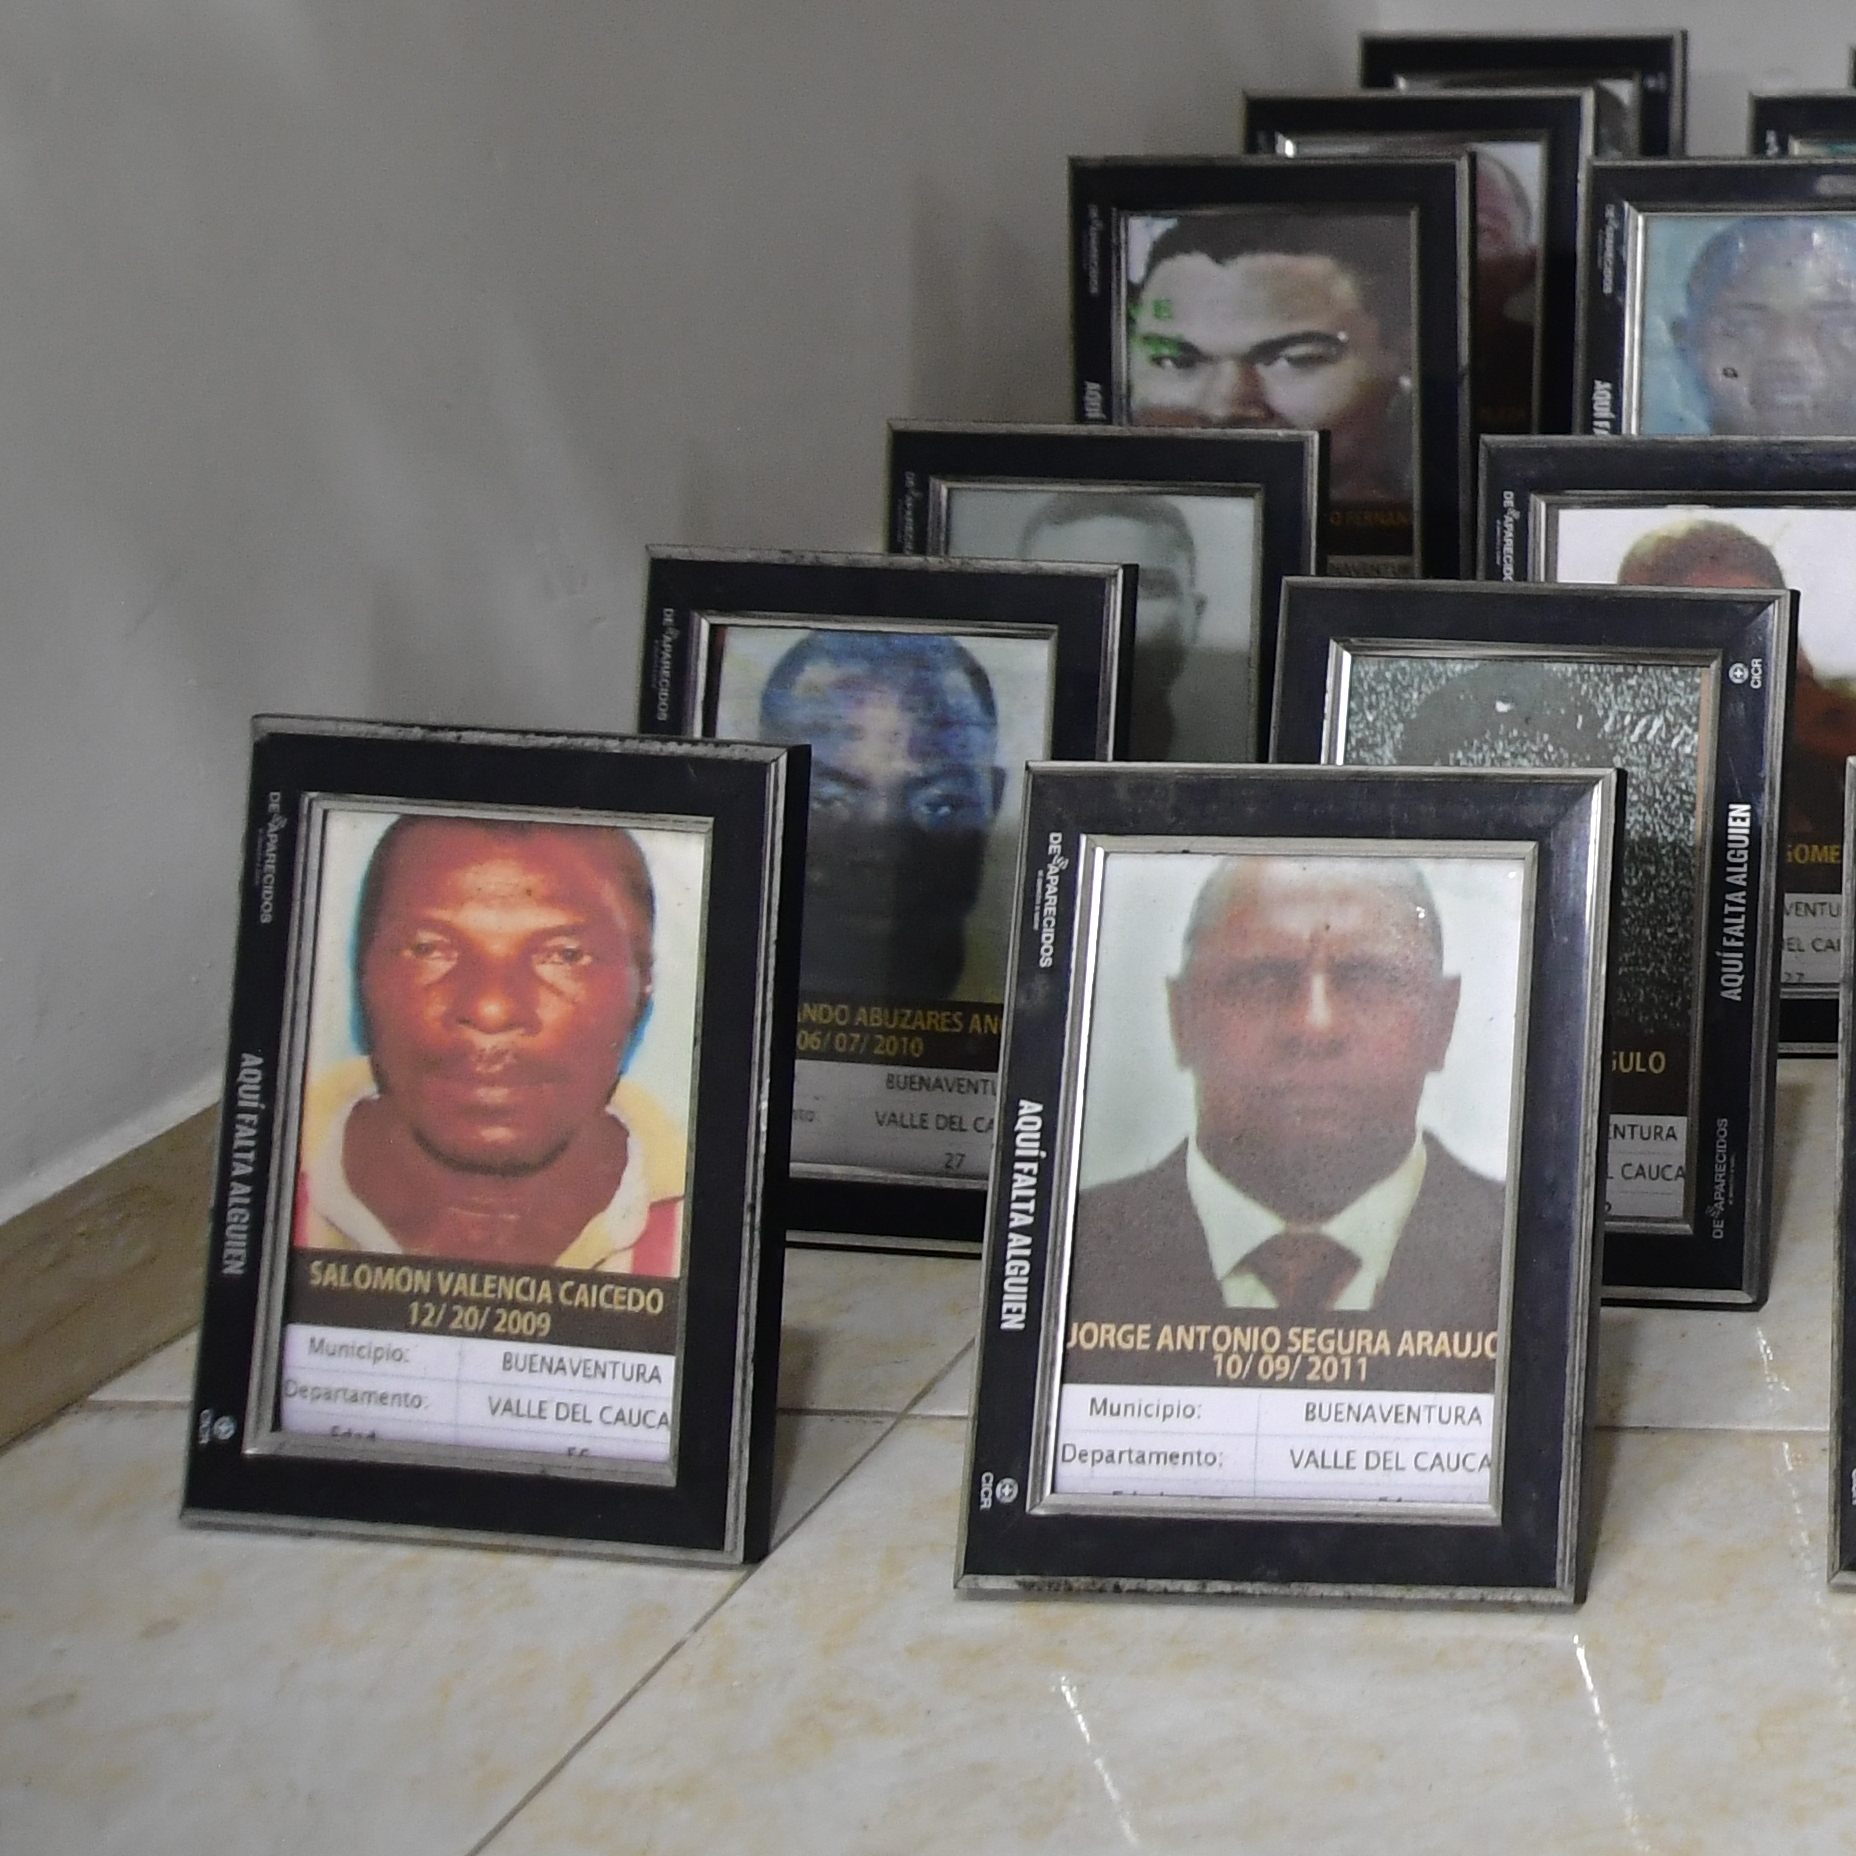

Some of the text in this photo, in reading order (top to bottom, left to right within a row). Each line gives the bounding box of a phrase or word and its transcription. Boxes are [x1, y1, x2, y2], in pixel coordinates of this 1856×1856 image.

[1727, 803, 1752, 886] ALGUIEN
[1722, 892, 1747, 945] FALTA
[855, 1007, 963, 1032] ABUZARES
[875, 1111, 929, 1129] VALLE
[935, 1114, 968, 1132] DEL
[222, 1052, 266, 1276] AQUÍ FALTA ALGUIEN
[1000, 1099, 1047, 1330] AQUÍ FALTA ALGUIEN
[437, 1272, 553, 1305] VALENCIA
[559, 1280, 664, 1314] CAICEDO
[494, 1308, 551, 1337] 2009
[1067, 1321, 1391, 1356] JORGE ANTONIO SEGURA
[502, 1351, 663, 1384] BUENAVENTURA
[1307, 1355, 1368, 1382] 2011
[489, 1395, 548, 1421] VALLE
[556, 1401, 593, 1424] DEL
[599, 1405, 669, 1429] CAUCA
[1089, 1397, 1482, 1426] Municipio: BUENAVENTURA
[1061, 1443, 1492, 1473] Departamento: VALLE DEL CAUCA
[979, 1471, 994, 1511] CICR
